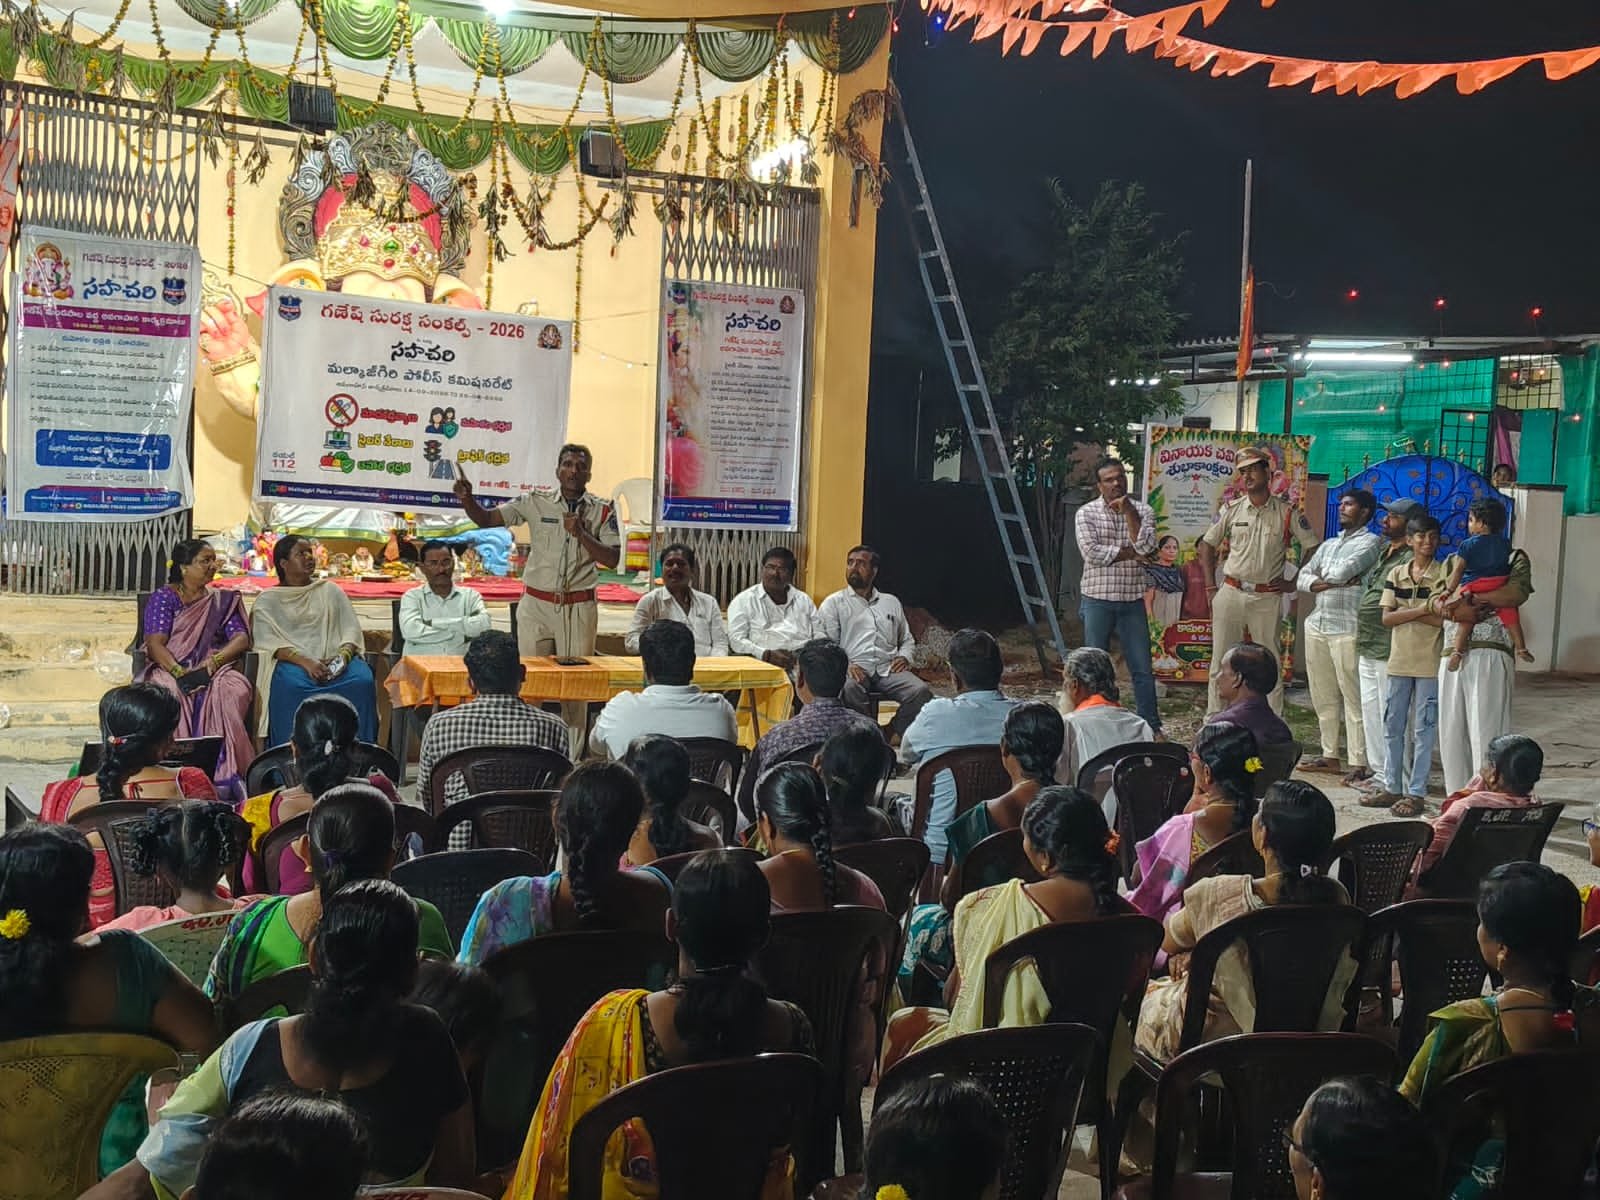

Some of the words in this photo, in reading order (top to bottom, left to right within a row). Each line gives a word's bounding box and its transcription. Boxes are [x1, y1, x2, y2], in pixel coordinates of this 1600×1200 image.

[82, 276, 157, 300] సహచరి
[321, 304, 364, 325] గణేష్
[370, 309, 413, 334] సురక్ష
[418, 314, 472, 339] సంకల్ప్
[489, 322, 525, 339] 2026
[725, 312, 781, 332] సహచరి
[390, 341, 456, 362] సహచరి
[403, 370, 443, 385] పోలీస్
[447, 376, 514, 391] కమిషనరేట్
[358, 433, 382, 449] సైబర్
[383, 434, 414, 449] నేరాలు
[271, 459, 297, 469] 112
[1159, 444, 1213, 465] వినాయక
[1215, 448, 1237, 462] చవి
[1165, 461, 1234, 478] శుభాకాంక్షలు
